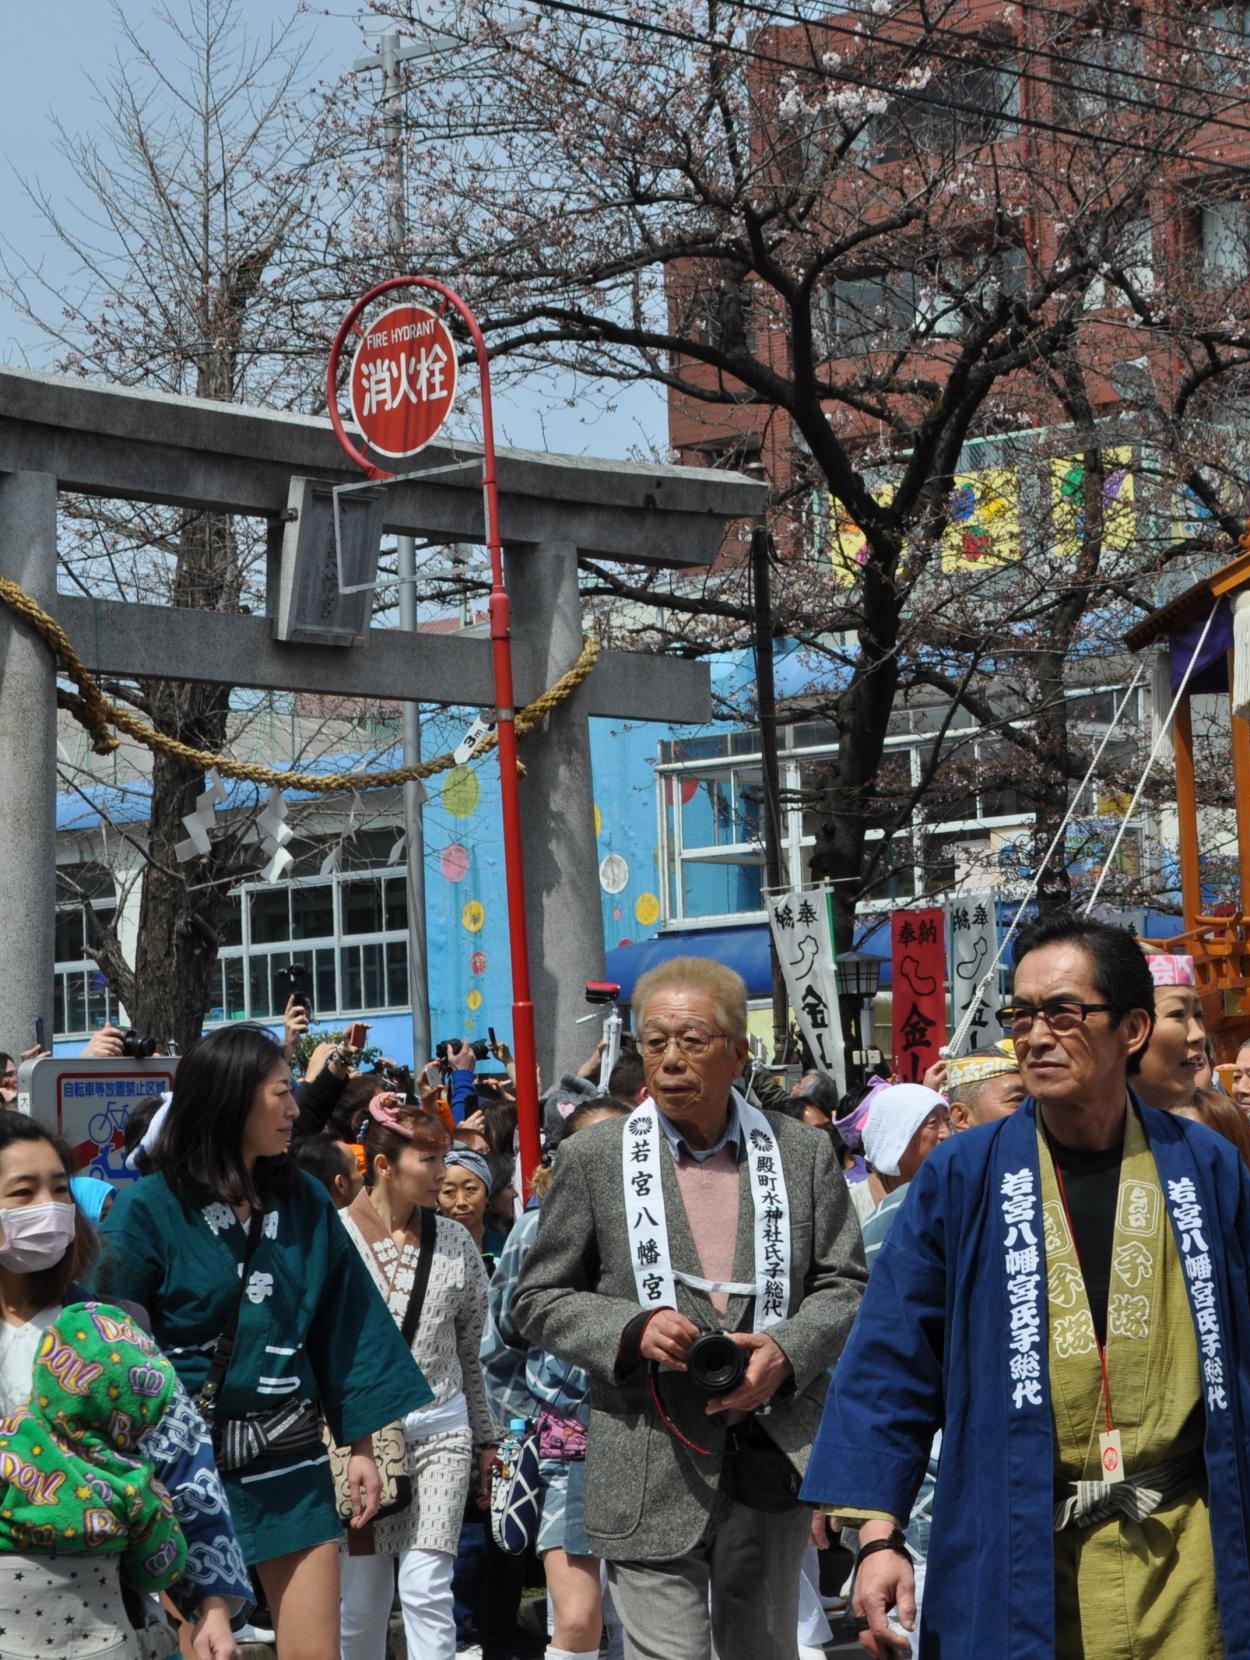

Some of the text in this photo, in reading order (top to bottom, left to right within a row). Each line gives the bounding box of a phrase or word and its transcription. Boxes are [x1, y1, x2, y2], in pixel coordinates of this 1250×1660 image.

[360, 344, 448, 417] 消火栓
[366, 319, 436, 351] FIRE HYDRANT
[897, 919, 937, 948] 奉納
[630, 1139, 664, 1302] 若宮八幡宮
[756, 1155, 785, 1318] 殿町水神社氏子総代
[1000, 1168, 1043, 1409] 若宮八幡宮氏子総代
[1167, 1177, 1228, 1412] 若宮八幡宮氏子総代
